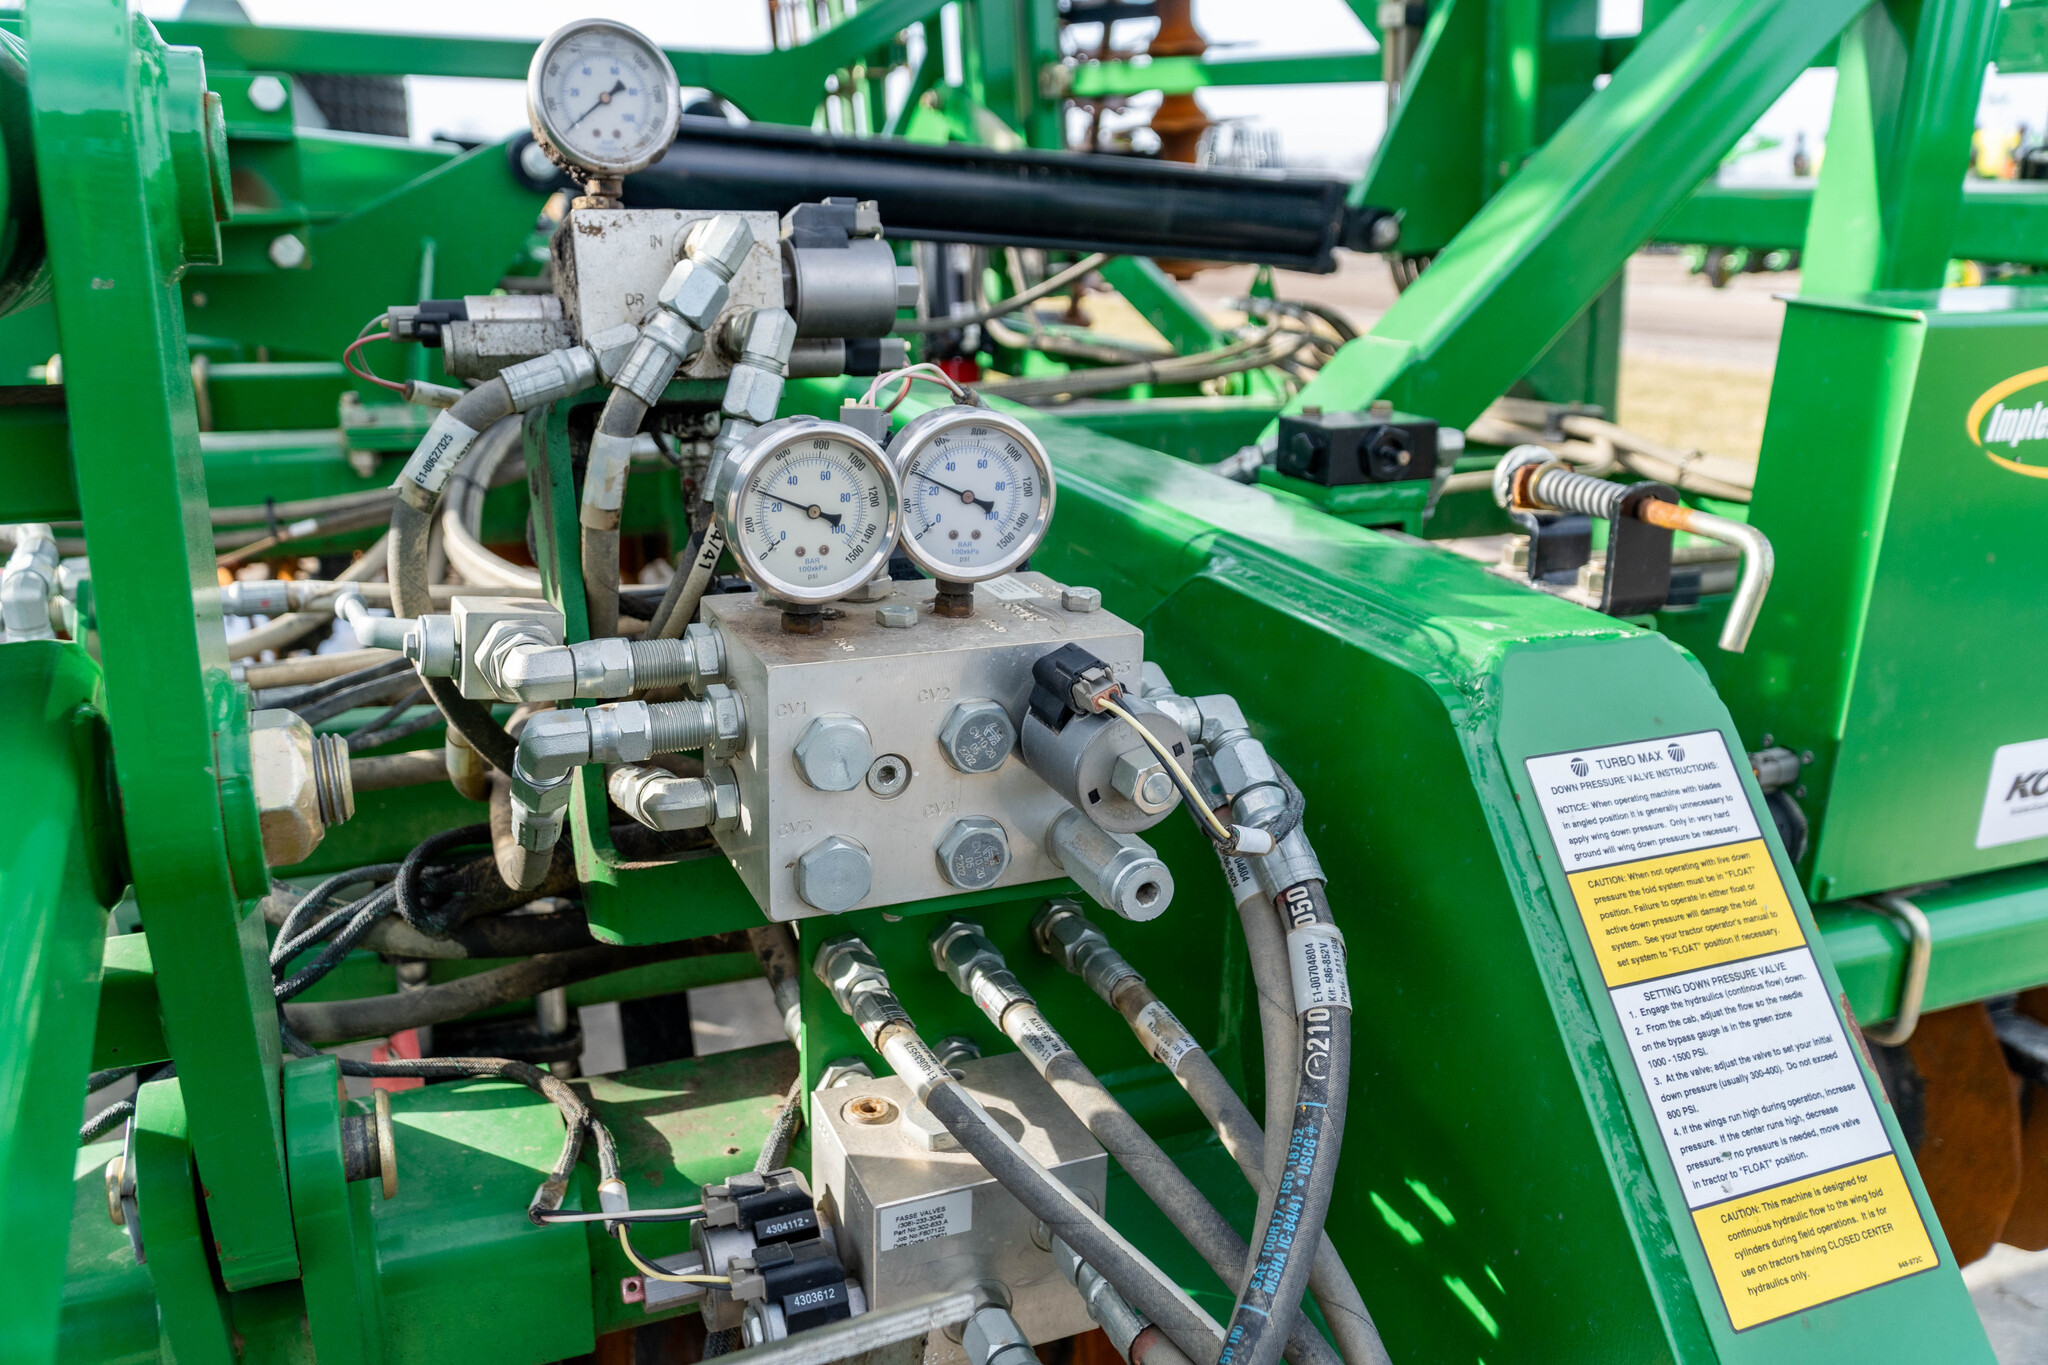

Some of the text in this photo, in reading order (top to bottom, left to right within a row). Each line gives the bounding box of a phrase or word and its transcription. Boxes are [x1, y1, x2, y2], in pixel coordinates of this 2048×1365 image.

[813, 440, 829, 450] 800
[1004, 442, 1022, 462] 1000
[416, 434, 454, 484] E1-00627325
[848, 452, 866, 471] 1000
[945, 462, 956, 471] 40
[977, 460, 988, 469] 60
[787, 476, 798, 485] 40
[820, 471, 831, 480] 60
[929, 486, 939, 496] 20
[995, 482, 1005, 491] 80
[1022, 477, 1033, 498] 1200
[772, 502, 782, 512] 20
[840, 493, 850, 502] 80
[868, 486, 879, 508] 1200
[936, 514, 941, 523] 0
[985, 511, 999, 520] 100
[1013, 512, 1029, 533] 1400
[780, 531, 786, 540] 0
[830, 524, 846, 534] 100
[861, 524, 876, 544] 1400
[699, 522, 722, 570] 4/41
[996, 532, 1015, 550] 1500
[760, 552, 768, 560] 0
[845, 545, 864, 564] 1500
[918, 688, 950, 703] CV2
[776, 702, 807, 718] CV1
[1594, 750, 1663, 770] TURBO MAX
[1550, 760, 1719, 795] DOWN PRESSURE VALVE INSTRUCTIONS:
[1556, 781, 1722, 814] NOTICE: When operating machine with blades
[923, 802, 956, 818] CV4
[1561, 821, 1571, 830] in
[1571, 816, 1598, 828] angled
[1598, 812, 1629, 825] position
[1629, 810, 1636, 818] it
[1644, 803, 1678, 817] generally
[1679, 796, 1724, 810] unnecessary
[1568, 834, 1589, 846] apply
[1589, 831, 1610, 840] wing
[1610, 828, 1631, 837] down
[1631, 822, 1667, 835] pressure.
[1669, 817, 1687, 827] Only
[1696, 814, 1712, 822] very
[1712, 809, 1730, 819] hard
[1573, 847, 1602, 862] ground
[1601, 844, 1616, 854] will
[1616, 842, 1636, 852] wing
[1636, 839, 1658, 848] down
[1657, 833, 1690, 846] pressure
[1701, 824, 1740, 836] necessary.
[1286, 885, 1317, 928] 050
[1305, 942, 1318, 1003] E1-00704804
[1319, 942, 1337, 1002] Kit: 586-852V
[1642, 961, 1787, 1001] SETTING DOWN PRESSURE VALVE
[1628, 973, 1806, 1019] 1. Engage the hydraulics (continous flow) down.
[1634, 990, 1803, 1036] 2. From the cab, adjust the flow so the needle
[1306, 1008, 1330, 1051] 210
[904, 1041, 938, 1081] E1-00689578
[1251, 1128, 1304, 1289] SAE 100R17 ISO 18752
[1720, 1174, 1868, 1224] CAUTION: This machine is designed for
[896, 1206, 946, 1222] FASSE VALVES
[1262, 1139, 1317, 1294] MSHA IC-84/41 USCG
[1727, 1187, 1884, 1242] continuous hydraulic flow to the wing fold
[1734, 1206, 1887, 1260] cylinders during field operations. It is for
[1740, 1222, 1894, 1278] use on tractors having CLOSED CENTER
[1746, 1270, 1810, 1296] hydraulics only.
[794, 1288, 835, 1306] 4303612
